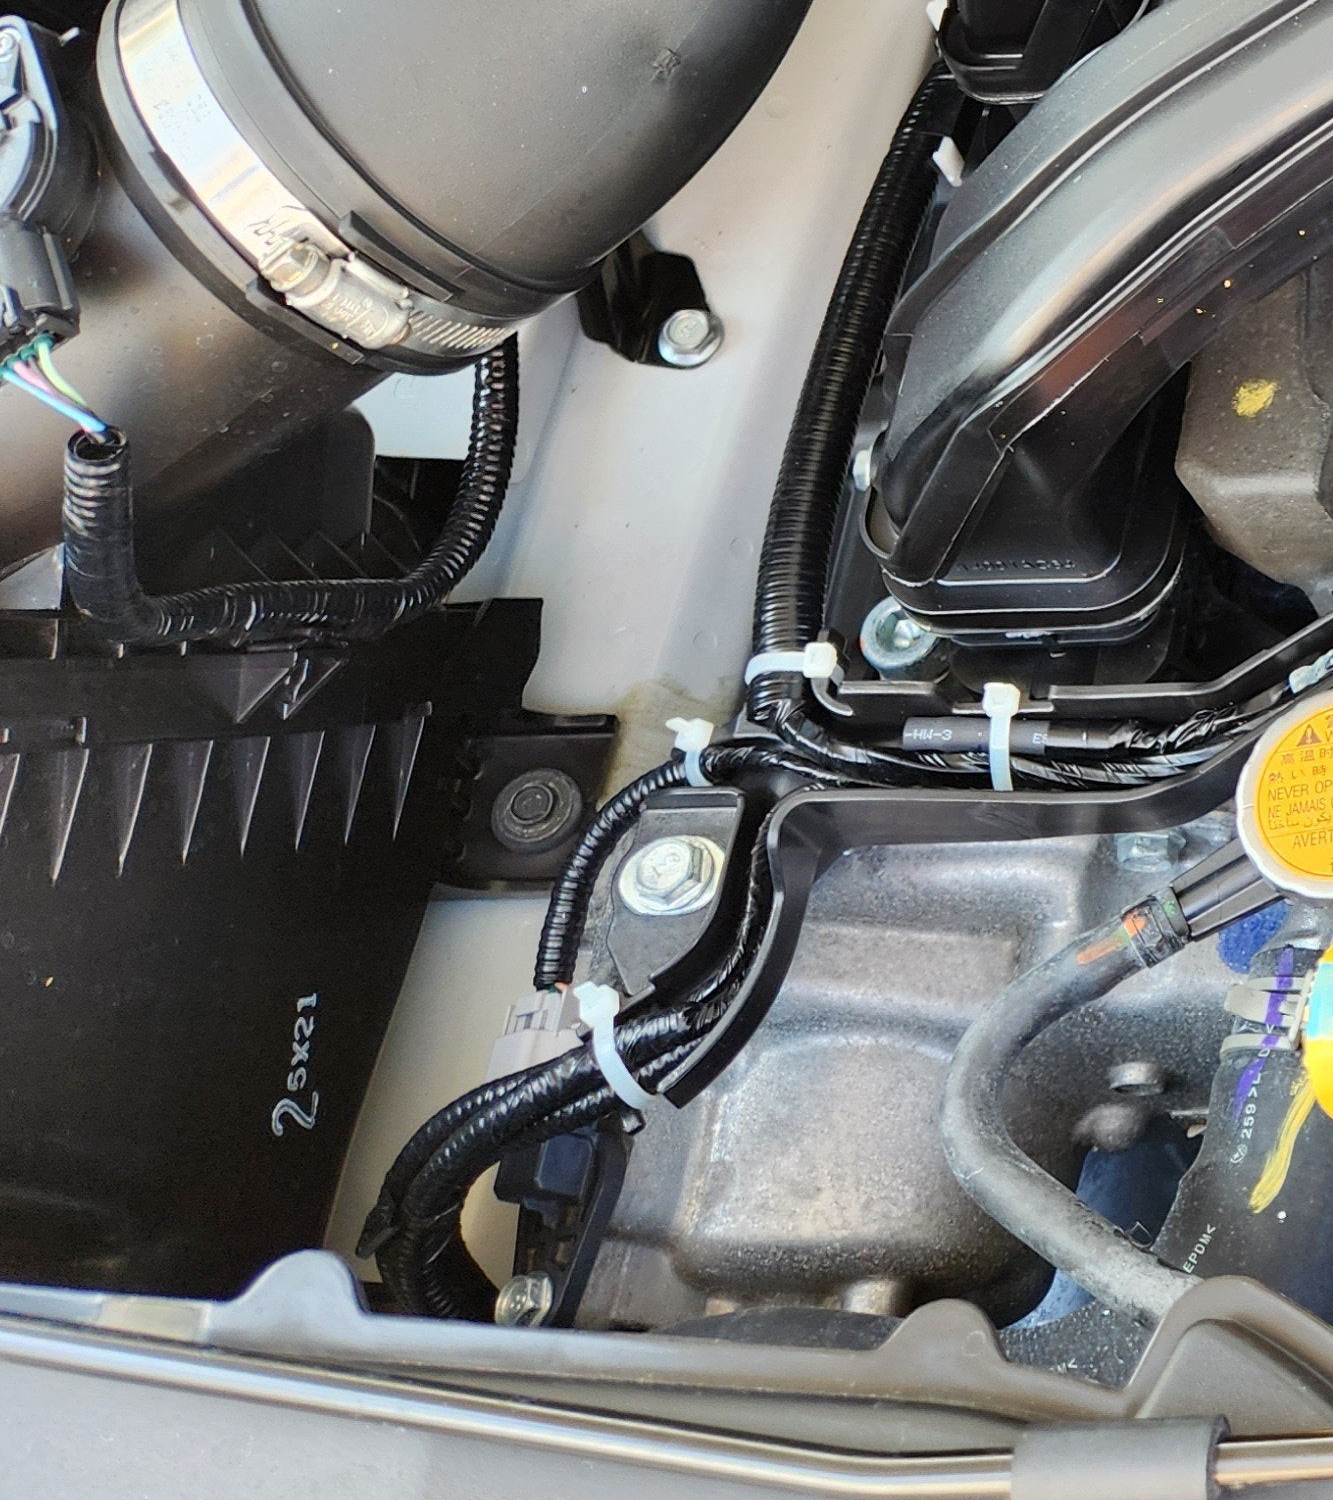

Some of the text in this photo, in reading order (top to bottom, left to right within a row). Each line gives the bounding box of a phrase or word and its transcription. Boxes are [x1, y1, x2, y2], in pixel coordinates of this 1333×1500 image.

[1268, 785, 1309, 801] NEVER
[1268, 805, 1281, 819] NE
[1286, 798, 1325, 817] JAMAIS
[1241, 1103, 1257, 1139] 259
